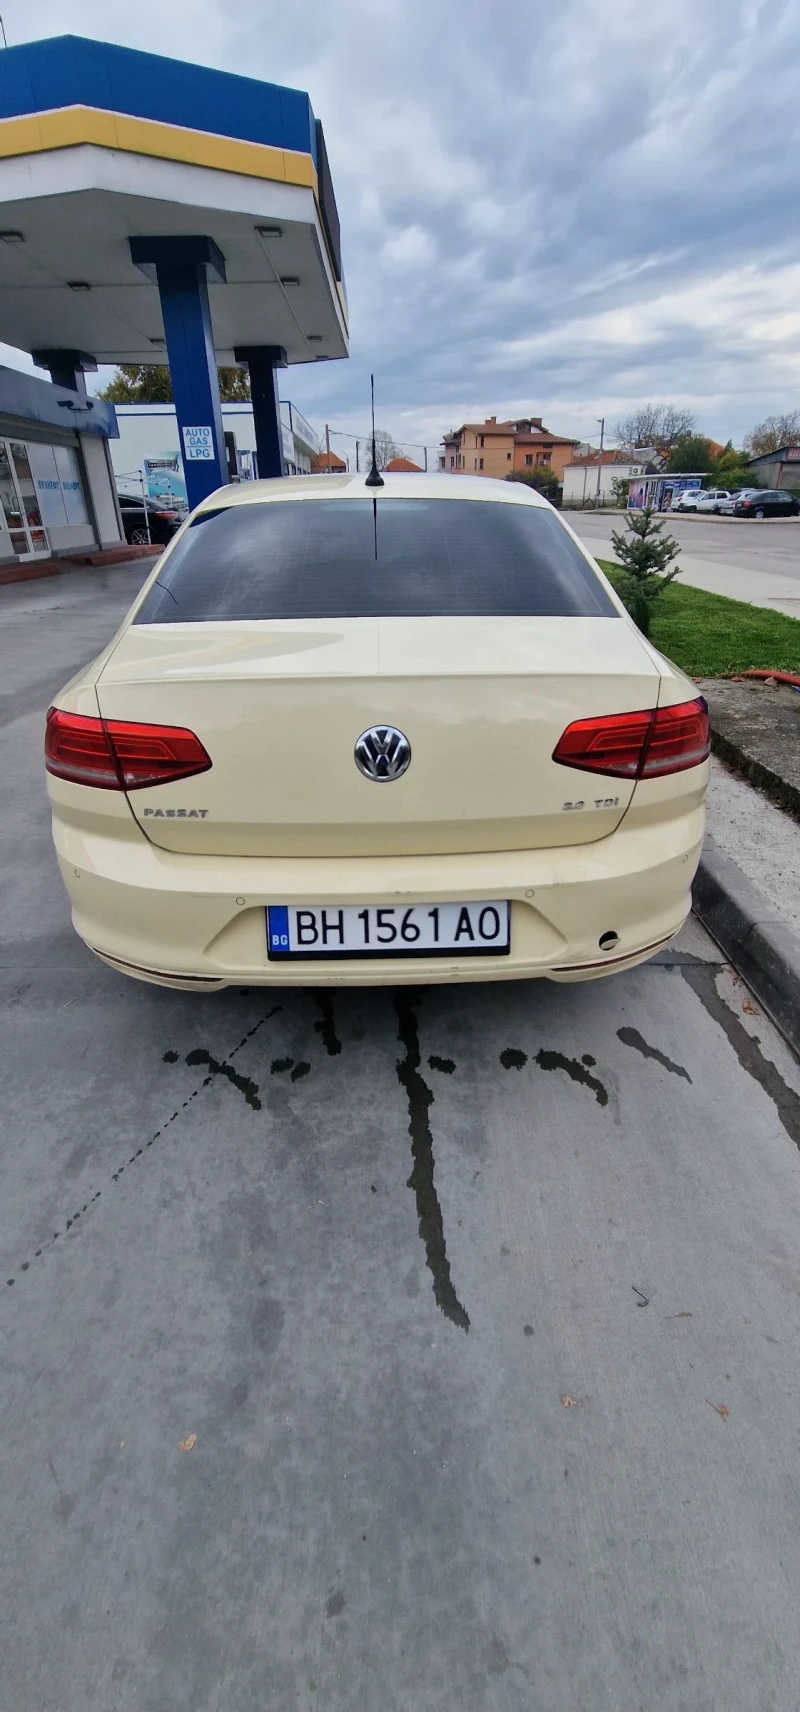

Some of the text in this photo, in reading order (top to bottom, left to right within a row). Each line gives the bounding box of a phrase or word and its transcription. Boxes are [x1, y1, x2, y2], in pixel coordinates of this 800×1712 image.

[185, 428, 210, 437] AUTO
[189, 437, 208, 445] GAS
[190, 449, 210, 458] LPG
[354, 724, 411, 783] VW
[143, 808, 208, 818] PASSAT
[296, 906, 500, 945] BH 1561 AO
[272, 934, 288, 946] BG
